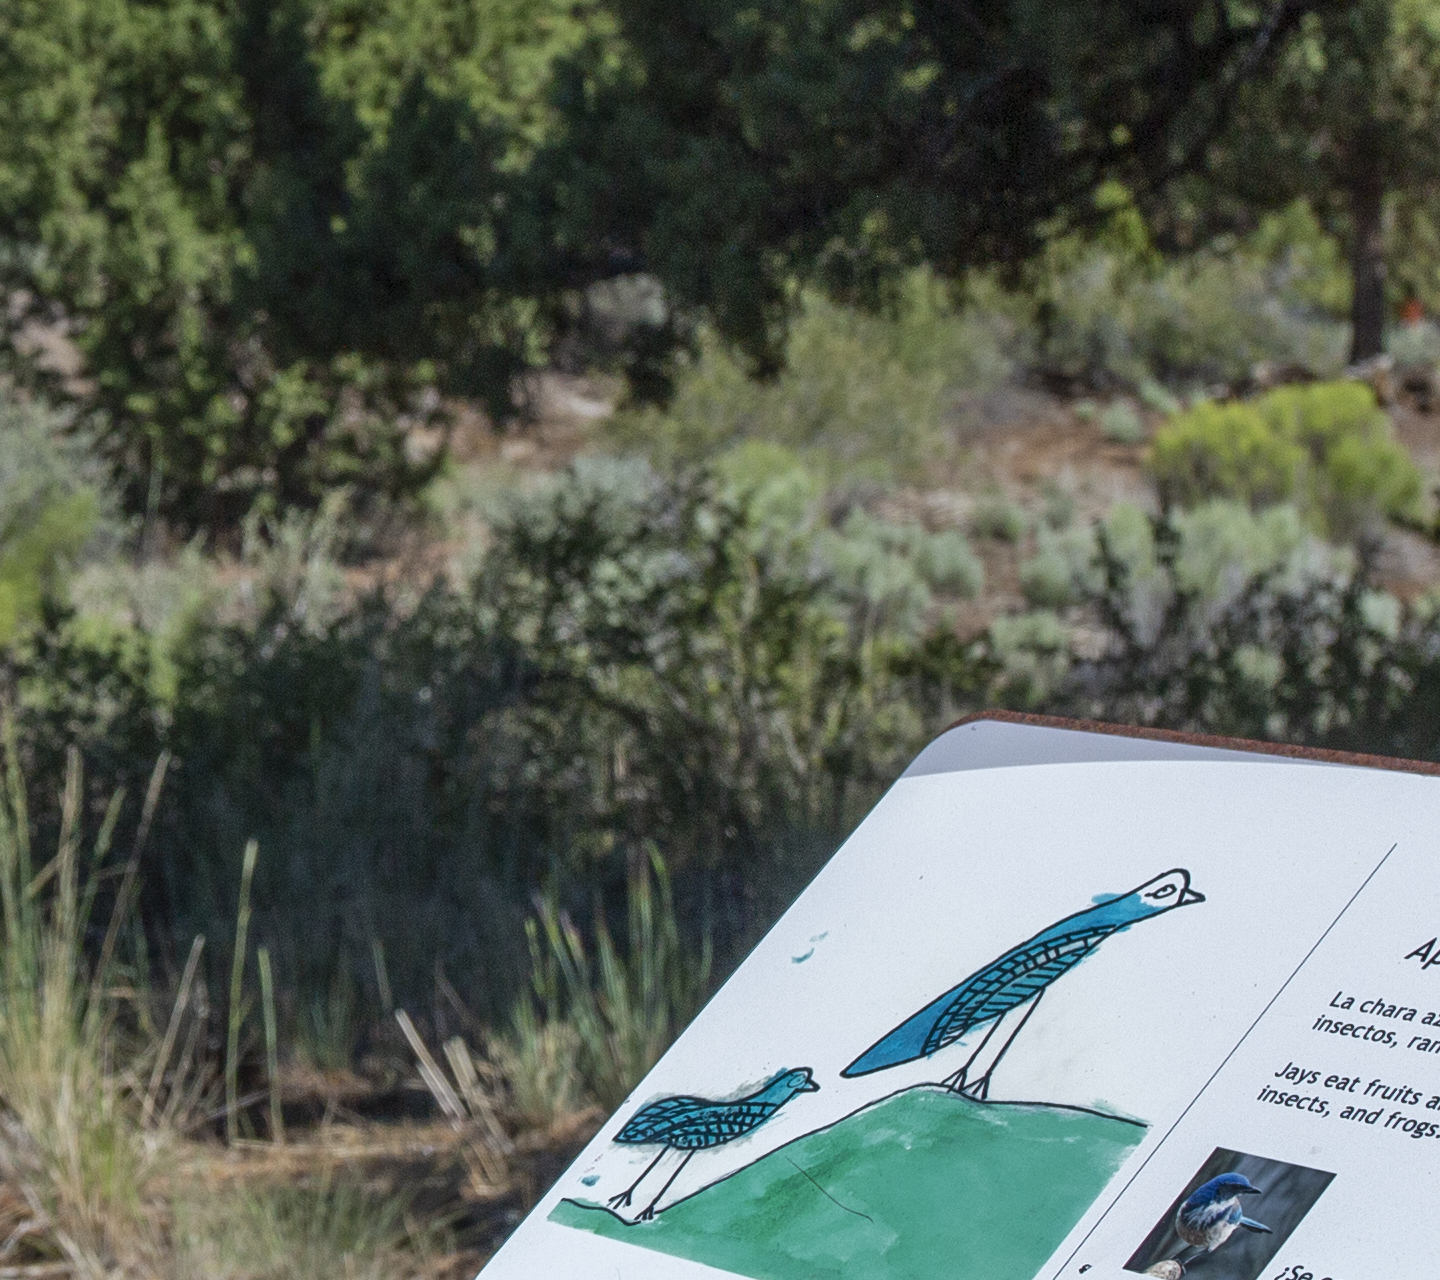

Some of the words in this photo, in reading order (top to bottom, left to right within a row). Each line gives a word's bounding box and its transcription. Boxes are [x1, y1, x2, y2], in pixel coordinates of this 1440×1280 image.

[1329, 990, 1356, 1010] La
[1359, 997, 1418, 1022] chara
[1312, 1014, 1398, 1049] insectos,
[1274, 1061, 1322, 1086] Jays
[1323, 1074, 1361, 1093] eat
[1362, 1078, 1424, 1106] fruits
[1256, 1084, 1330, 1118] insects,
[1339, 1105, 1385, 1125] and
